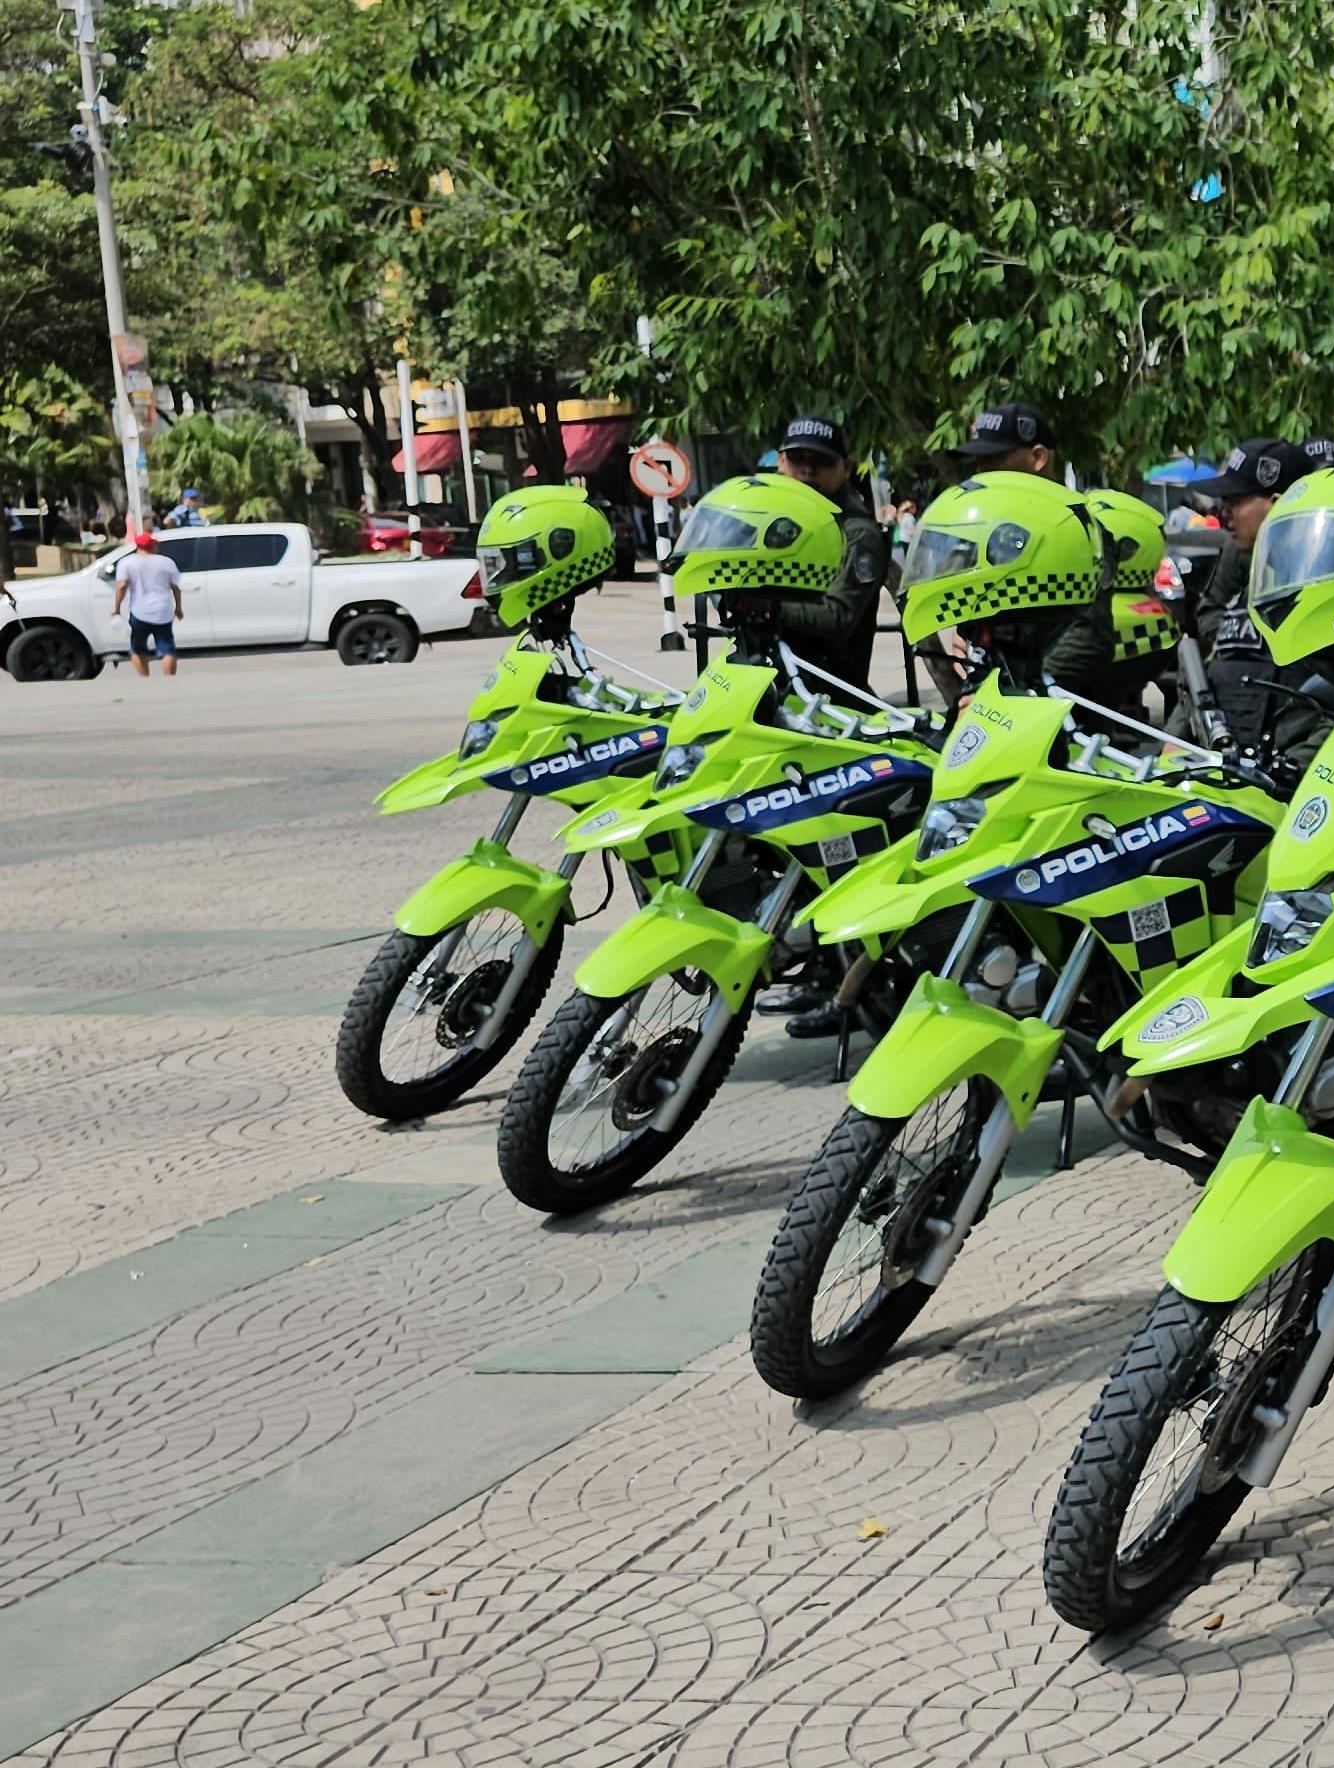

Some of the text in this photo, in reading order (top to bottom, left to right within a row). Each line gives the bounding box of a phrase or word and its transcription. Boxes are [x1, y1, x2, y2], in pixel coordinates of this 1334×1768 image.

[530, 737, 641, 780] POLICÍA
[746, 766, 873, 817] POLICÍA
[1040, 816, 1187, 884] POLICÍA
